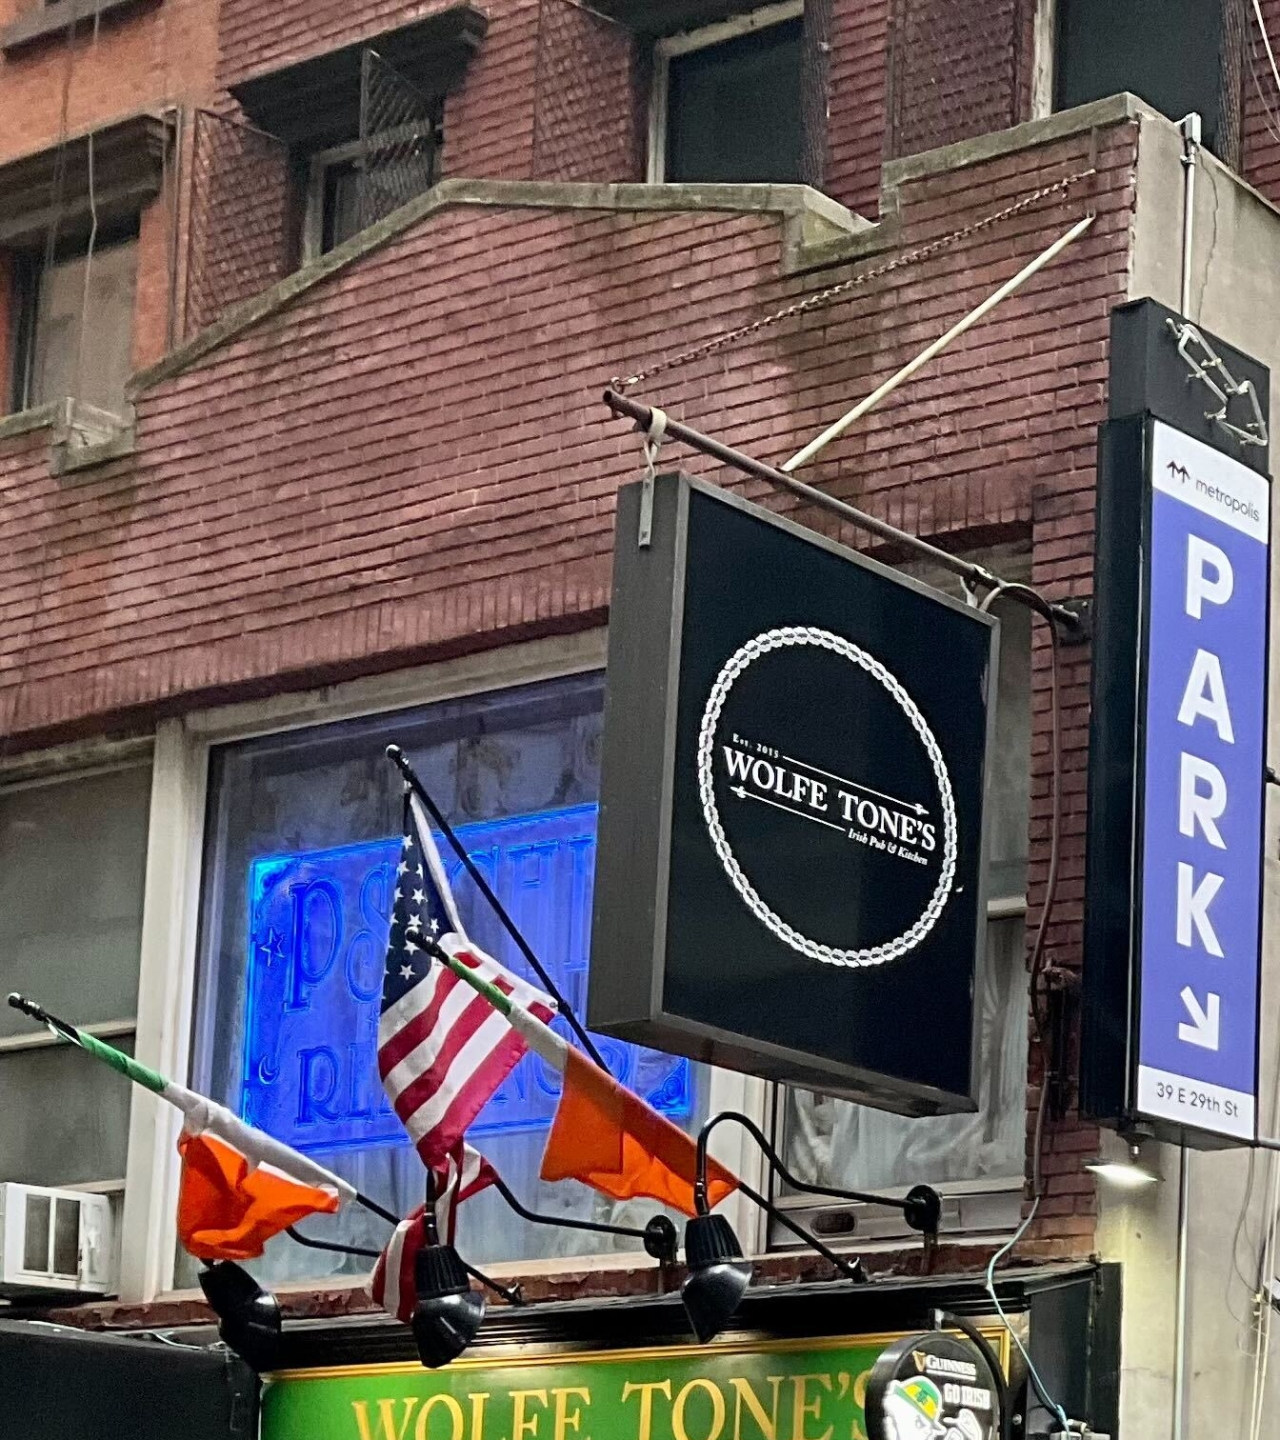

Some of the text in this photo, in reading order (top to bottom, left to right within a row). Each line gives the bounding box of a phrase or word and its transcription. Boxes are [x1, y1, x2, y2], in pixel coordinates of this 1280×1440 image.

[1195, 477, 1260, 522] metropolis
[756, 743, 779, 759] 2015
[1176, 533, 1235, 958] PARK
[722, 746, 936, 851] WOLFE TONE'S
[1156, 1082, 1239, 1117] 39 E 29th St
[926, 1354, 977, 1376] GUINNESS
